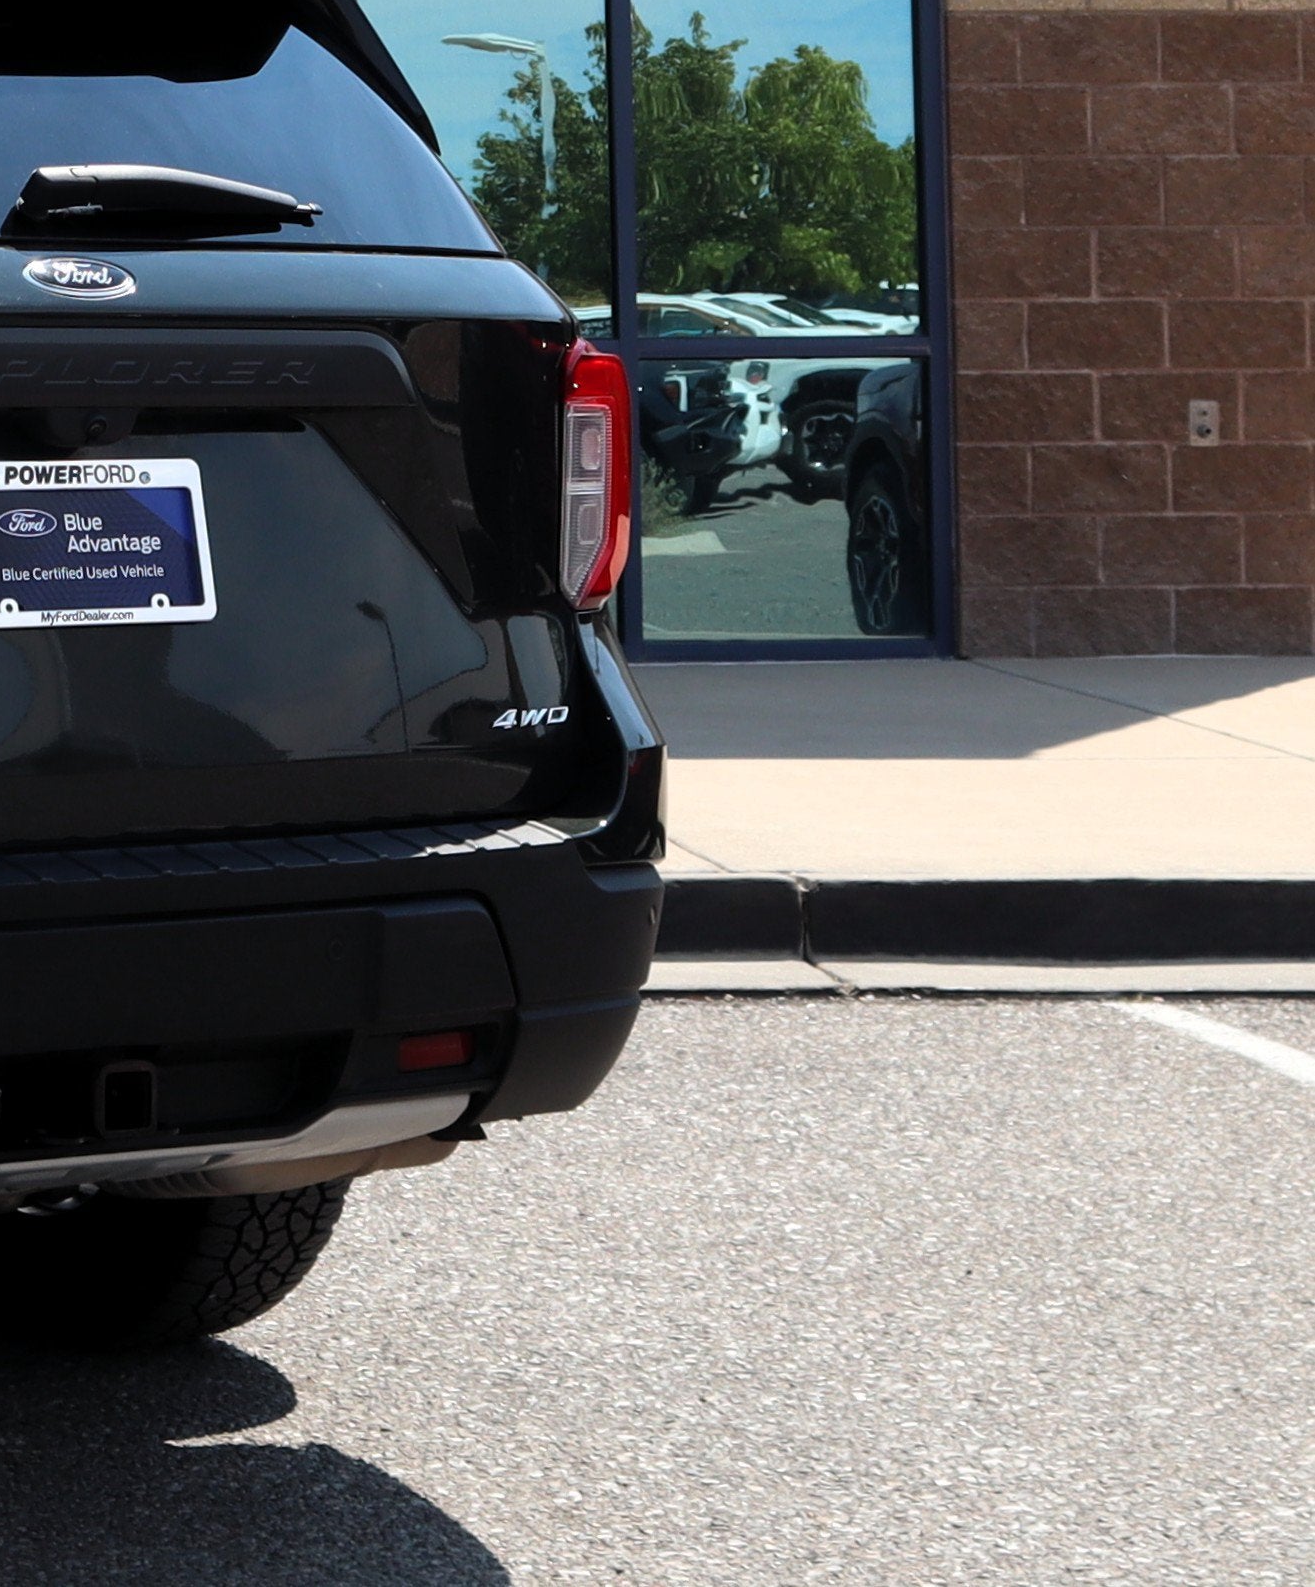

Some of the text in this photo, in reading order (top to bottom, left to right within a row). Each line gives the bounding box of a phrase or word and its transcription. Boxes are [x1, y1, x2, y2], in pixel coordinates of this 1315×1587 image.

[51, 261, 113, 285] Ford
[4, 465, 136, 484] POWERFORD
[8, 513, 46, 532] Ford
[64, 514, 103, 531] Blue
[68, 535, 161, 554] Advantage
[2, 564, 165, 582] Blue Certified Used Vehicle
[41, 609, 134, 626] MyFordDealer.com
[492, 706, 569, 728] 4WD
